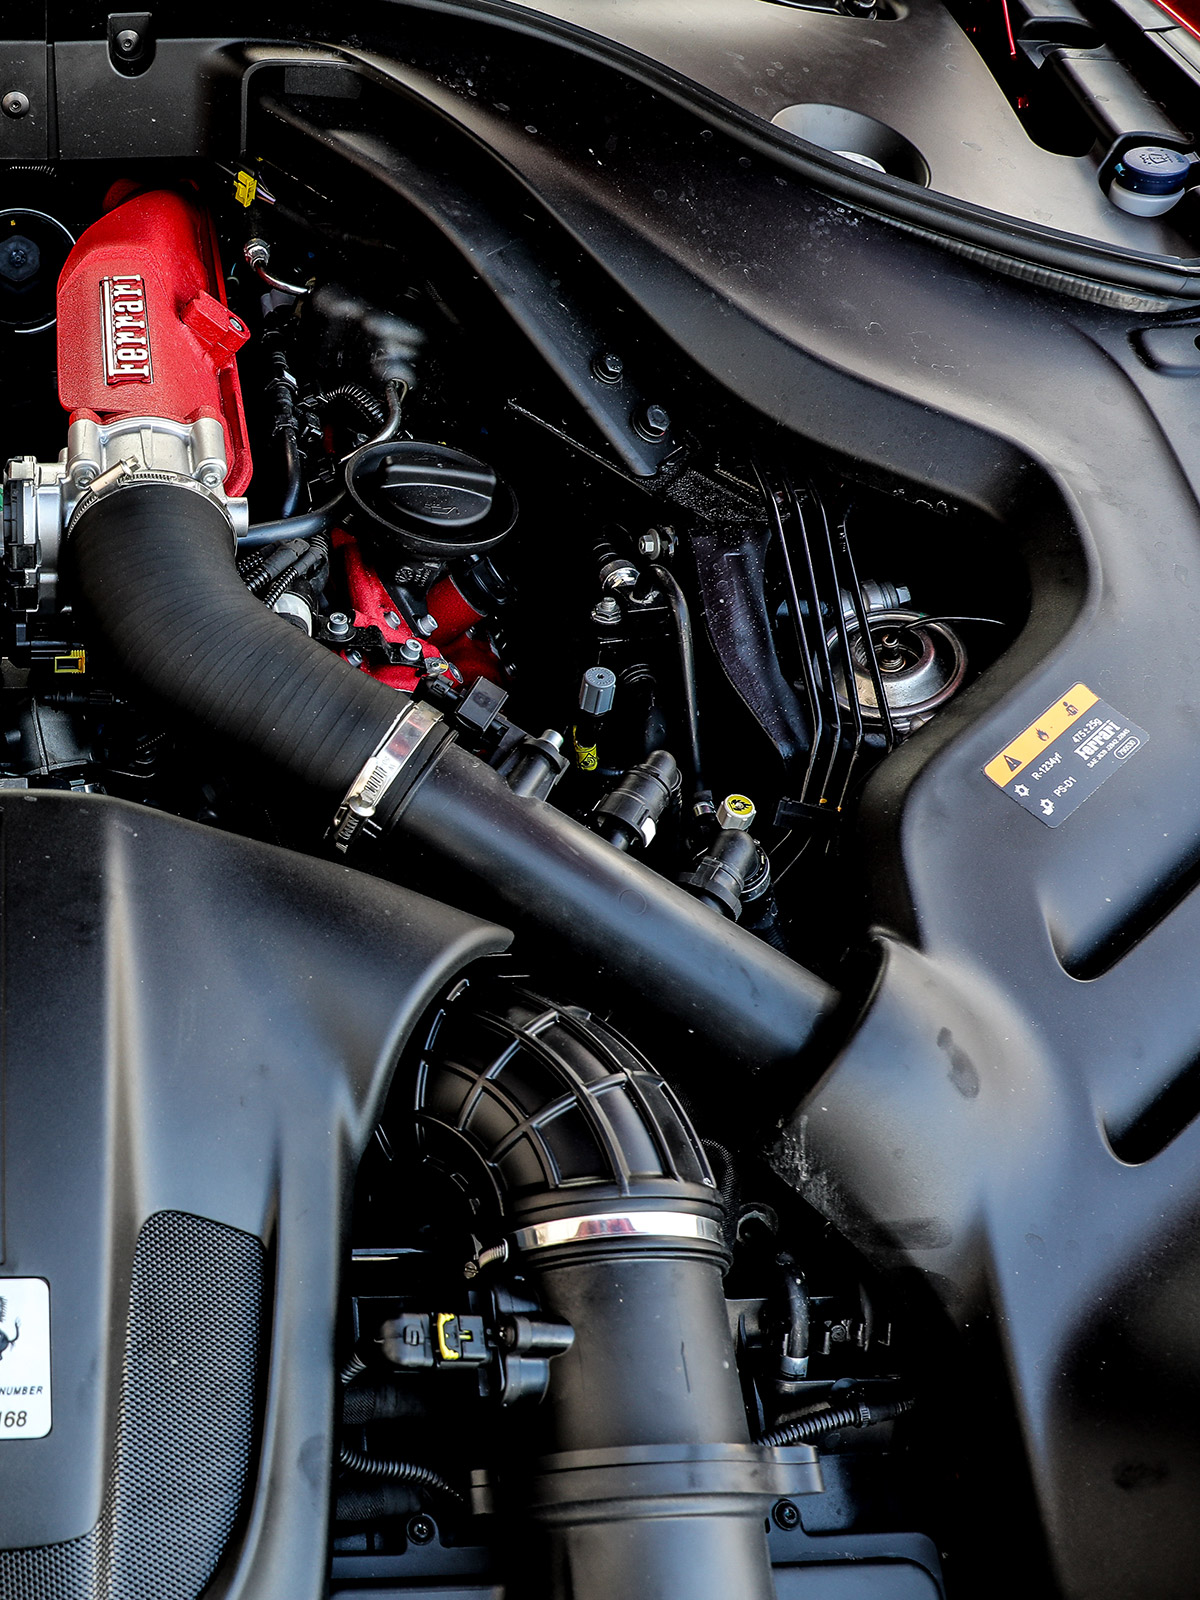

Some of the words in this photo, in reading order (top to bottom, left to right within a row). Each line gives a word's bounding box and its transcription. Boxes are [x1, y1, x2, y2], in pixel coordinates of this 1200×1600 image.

[103, 274, 150, 377] Ferrari
[1074, 719, 1121, 761] Ferrari
[1031, 751, 1063, 781] R-1234yf
[1053, 776, 1077, 797] PS-D1
[0, 1385, 44, 1396] NUMBER
